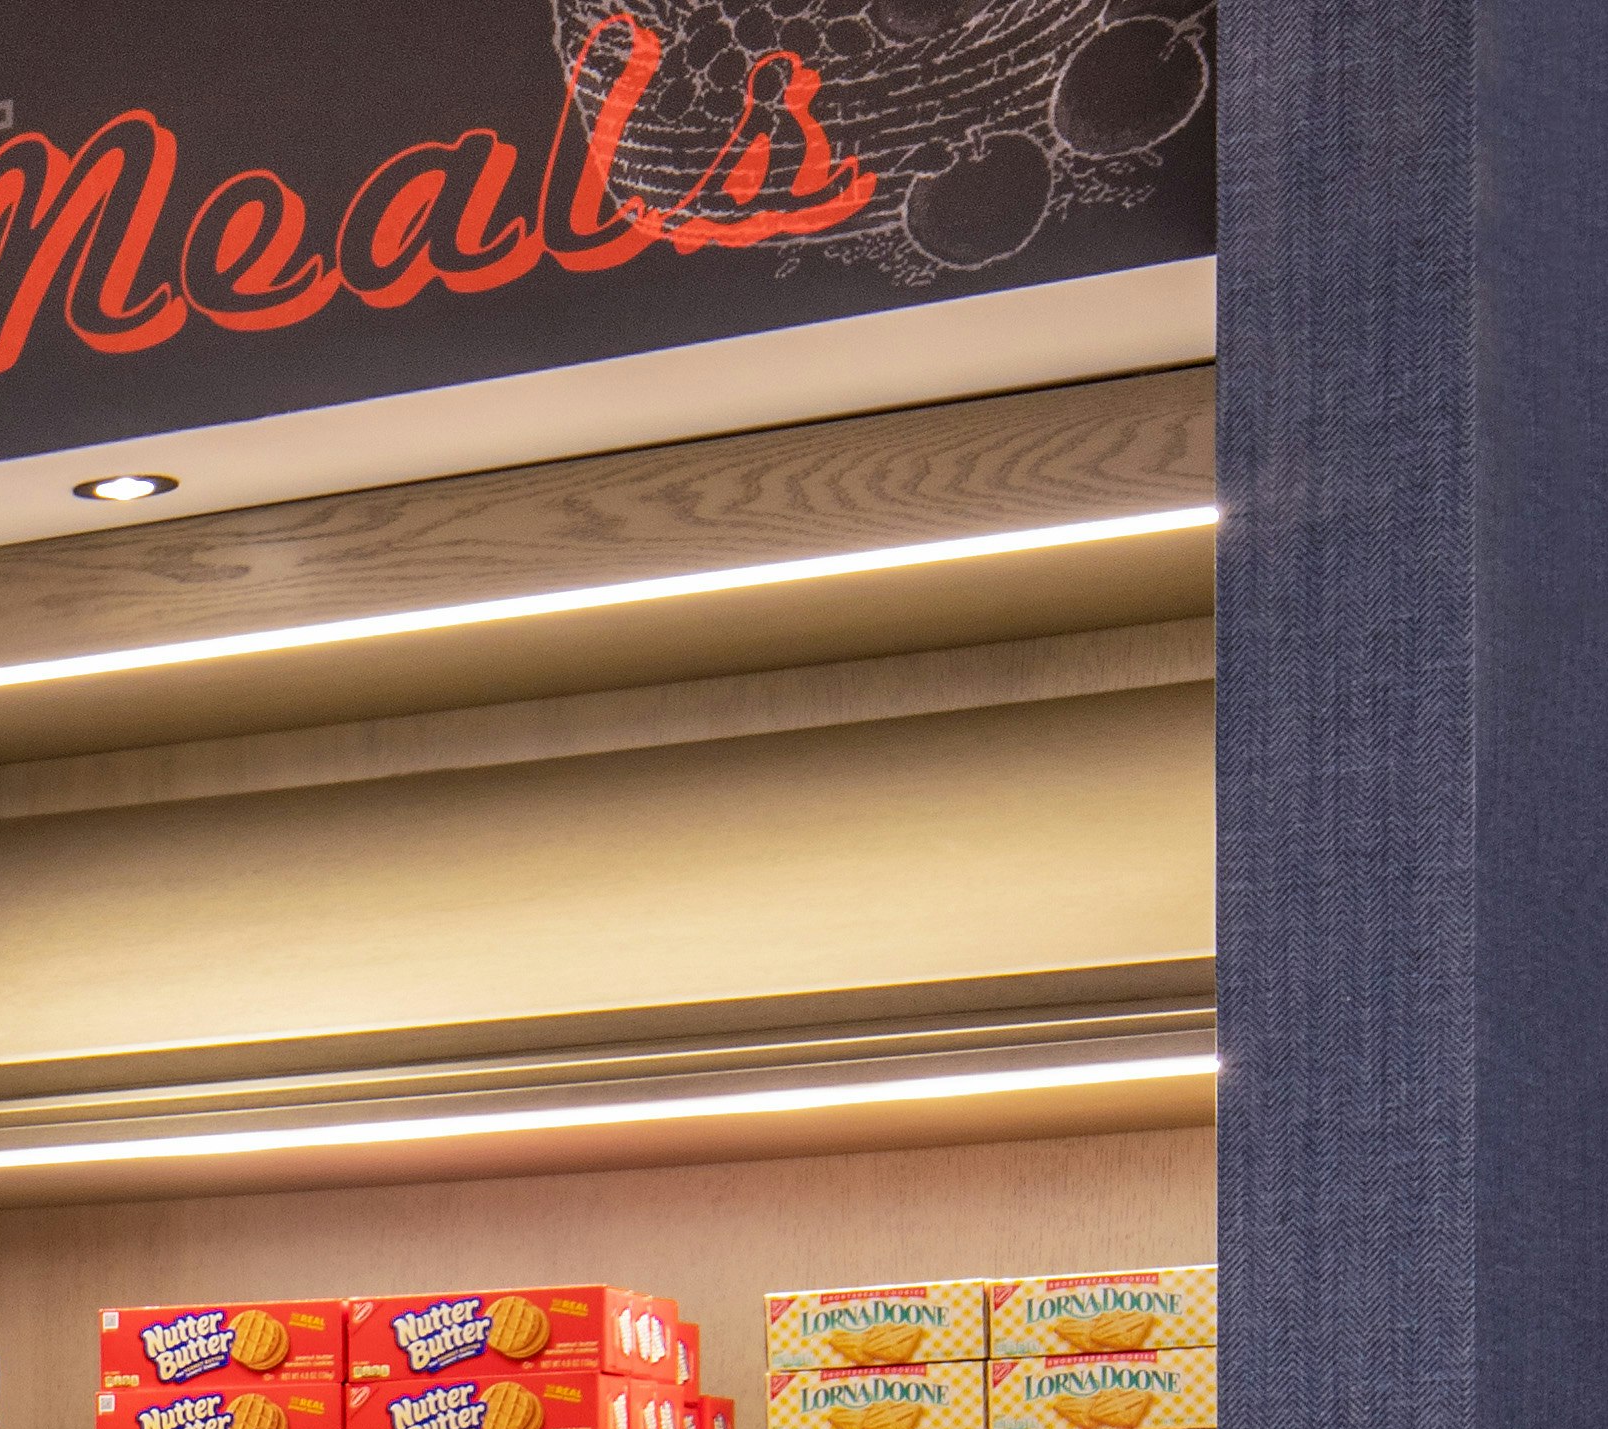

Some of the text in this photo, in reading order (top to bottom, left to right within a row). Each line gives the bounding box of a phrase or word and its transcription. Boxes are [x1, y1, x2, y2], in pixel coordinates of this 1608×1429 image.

[392, 1298, 481, 1347] Nutter
[799, 1300, 951, 1338] LORNA DOONE
[1024, 1287, 1183, 1325] LORNA DOONE
[142, 1310, 225, 1358] Nutter
[155, 1329, 235, 1382] Butter
[407, 1316, 492, 1374] Butter
[799, 1377, 951, 1415] LORNA DOONE
[1023, 1365, 1181, 1402] LORNA DOONE
